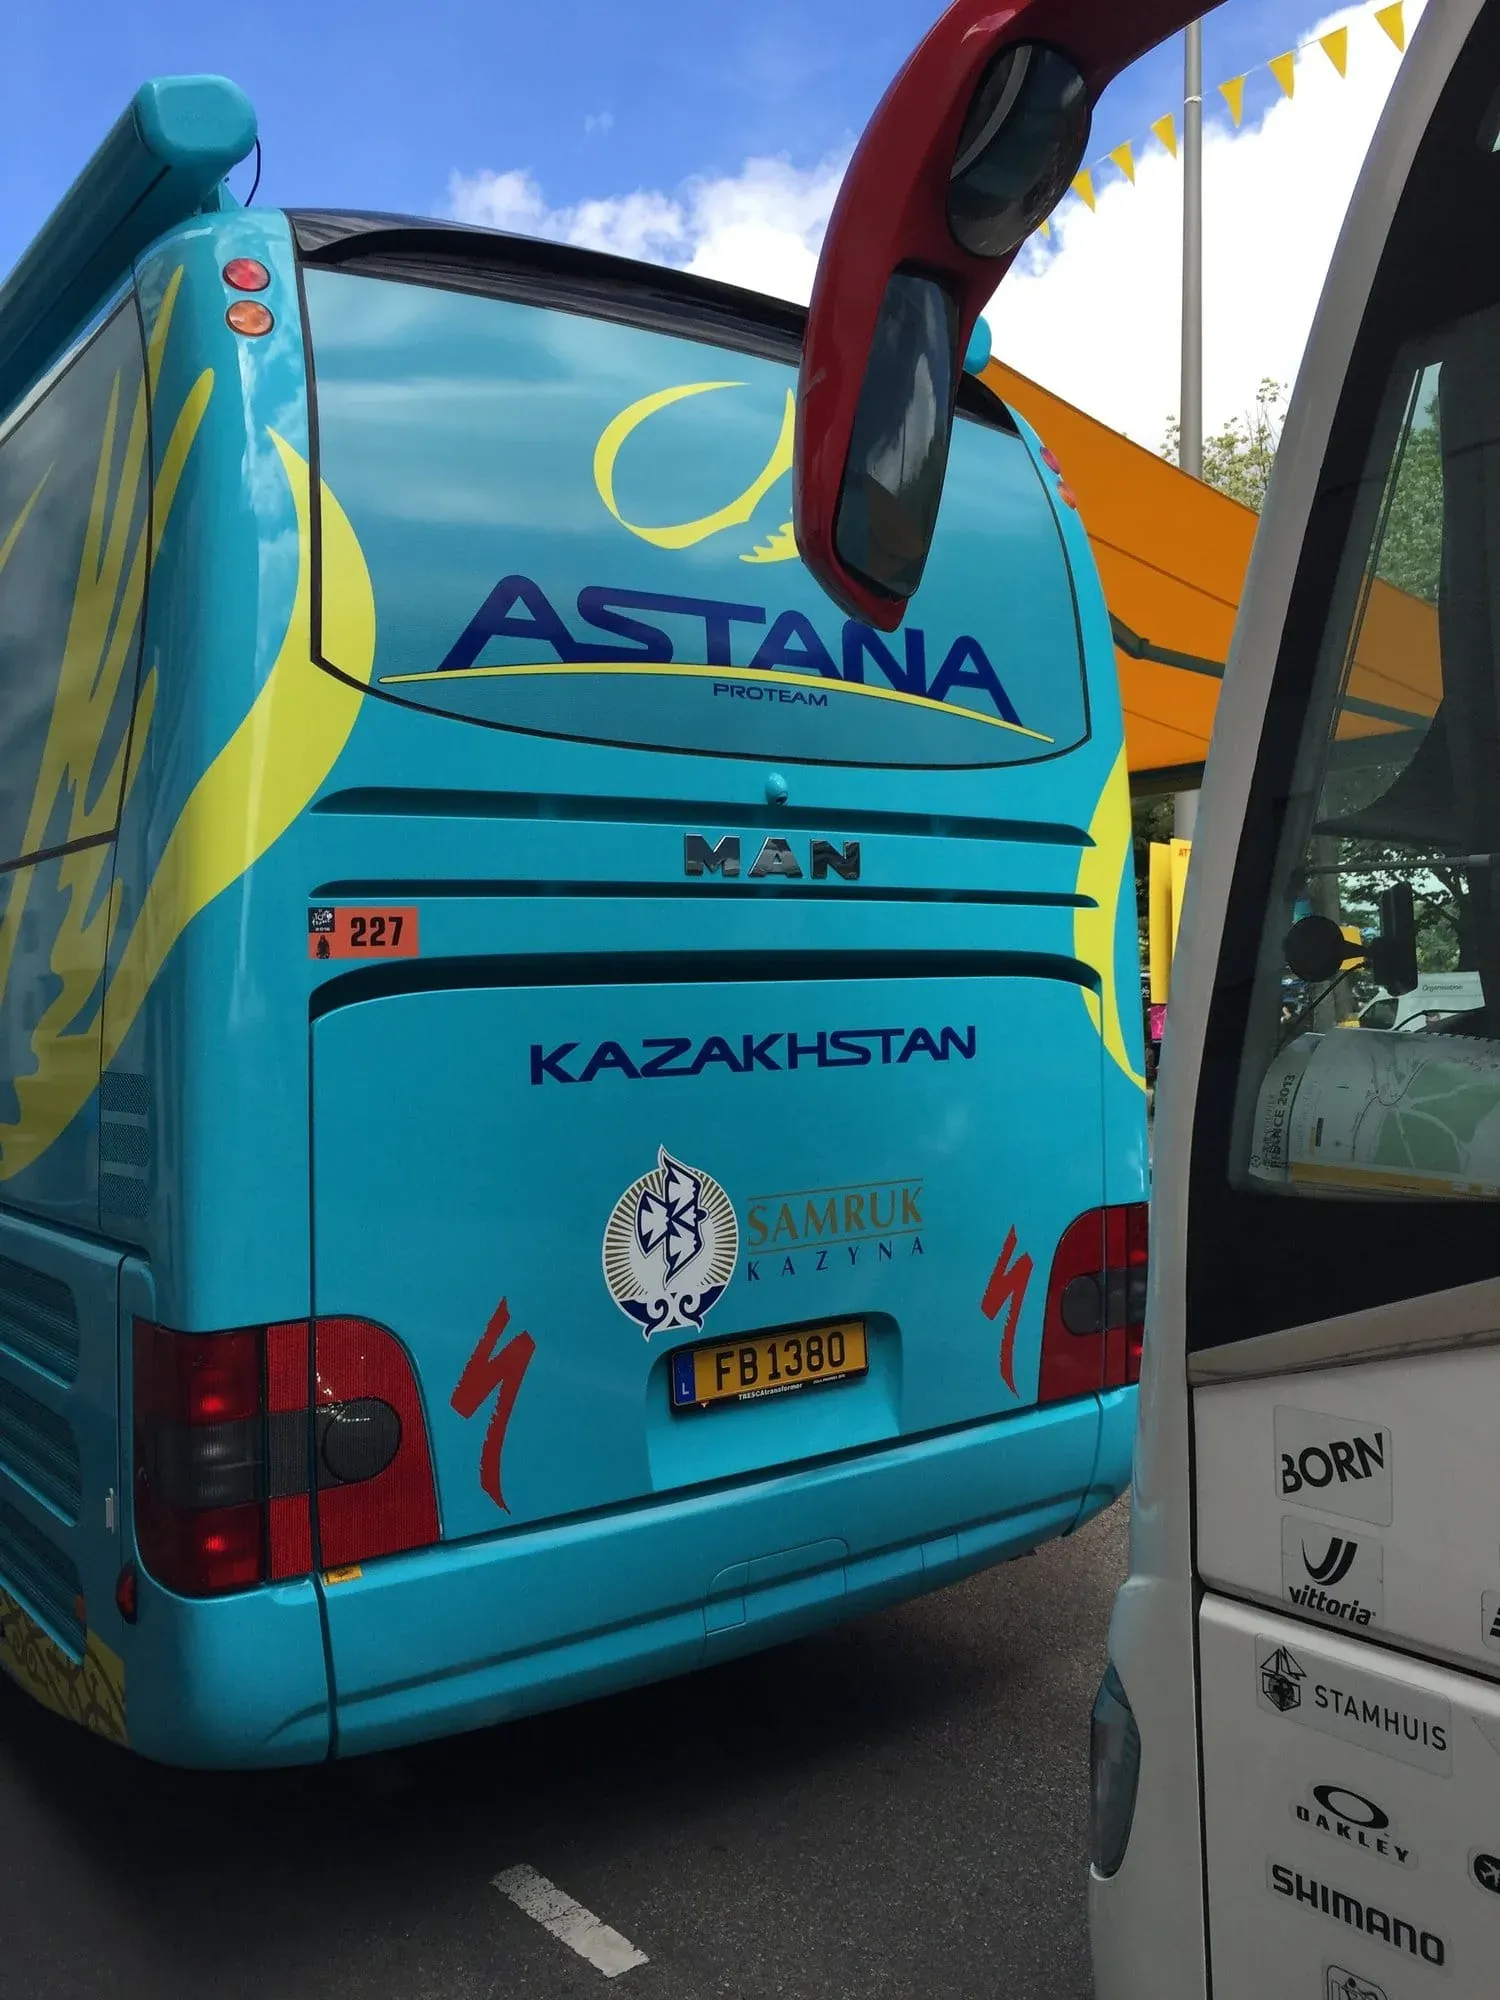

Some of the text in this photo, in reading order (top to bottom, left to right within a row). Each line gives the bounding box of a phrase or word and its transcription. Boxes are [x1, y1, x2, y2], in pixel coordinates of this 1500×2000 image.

[436, 575, 1023, 727] ASTANA
[713, 683, 828, 707] PROTEAM
[683, 833, 862, 880] MAN
[351, 916, 403, 947] 227
[530, 1025, 976, 1085] KAZAKHSTAN
[1277, 1074, 1296, 1106] 2013
[747, 1187, 924, 1247] SAMRUK
[747, 1236, 925, 1282] KAZYNA
[681, 1382, 689, 1396] L
[1281, 1432, 1385, 1494] BORN
[1288, 1584, 1373, 1627] vittoria
[1314, 1684, 1447, 1752] STAMHUIS
[1296, 1804, 1409, 1864] OAKLEY
[1271, 1863, 1444, 1967] SHIMANO
